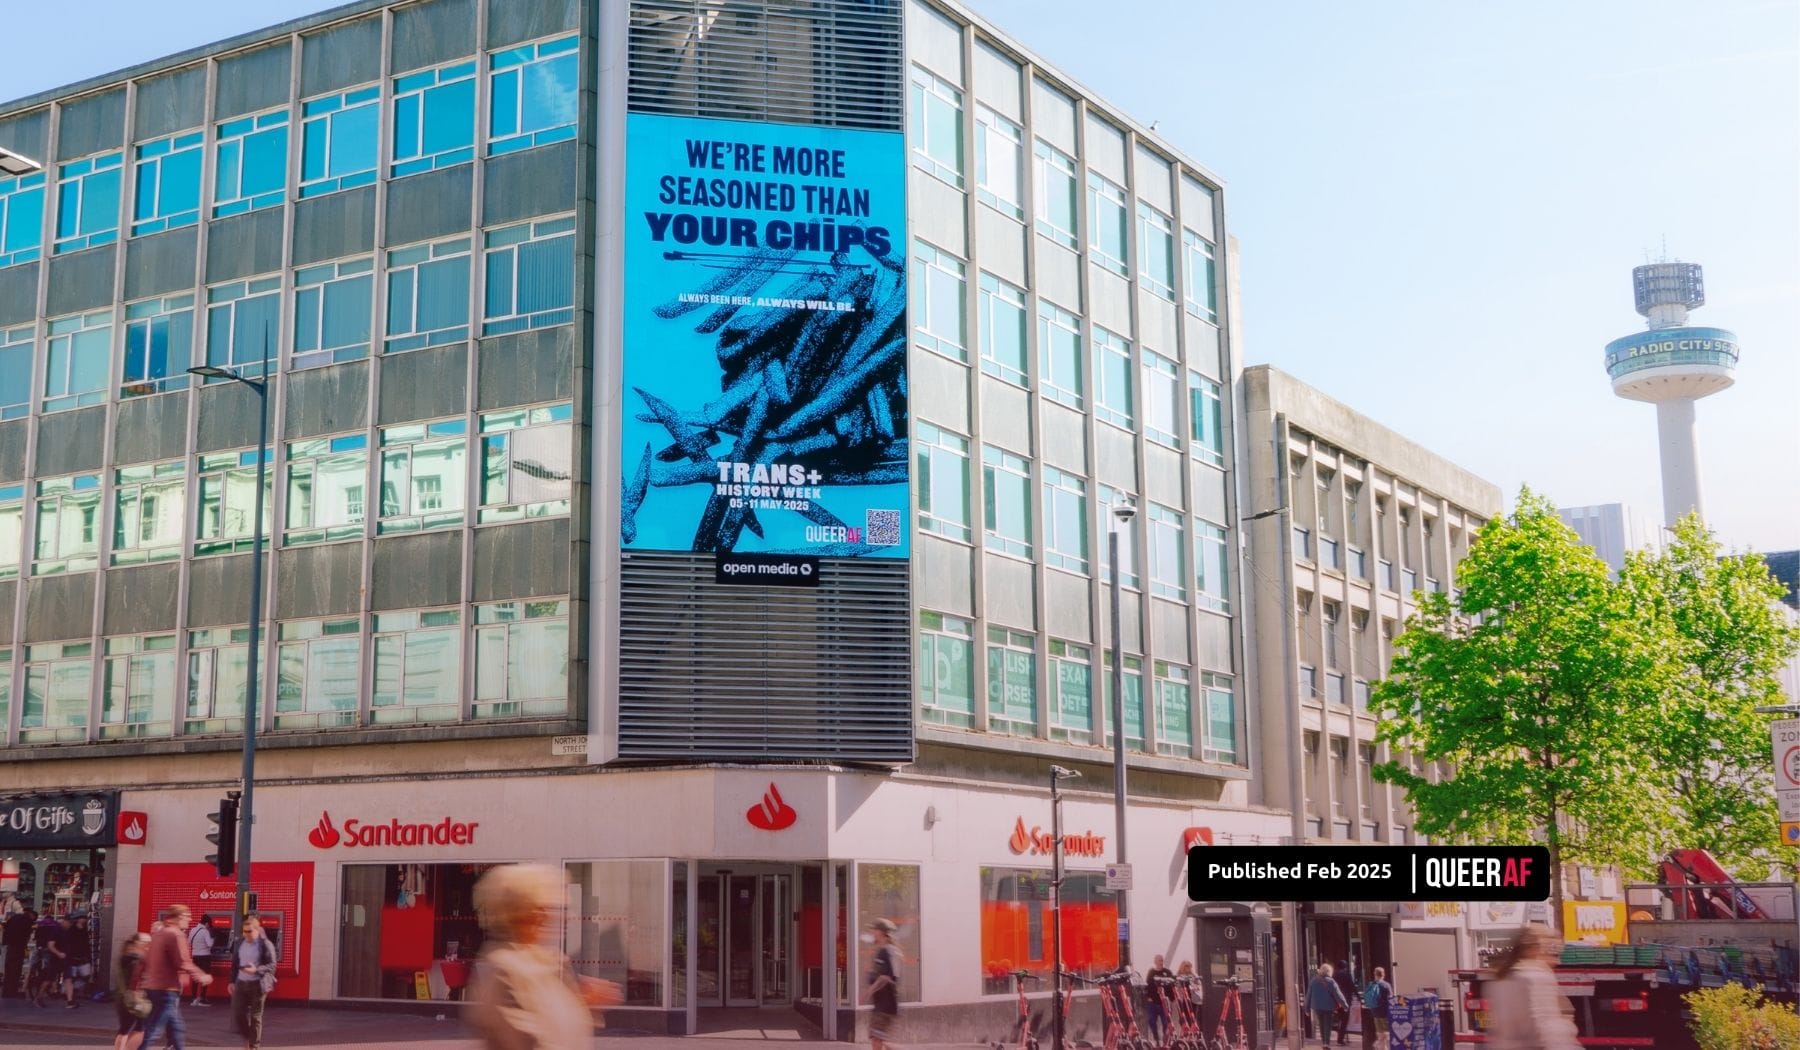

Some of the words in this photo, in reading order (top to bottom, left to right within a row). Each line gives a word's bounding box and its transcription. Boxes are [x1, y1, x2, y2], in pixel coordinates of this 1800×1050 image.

[685, 139, 765, 173] WE’RE
[773, 145, 846, 178] MORE
[658, 175, 796, 213] SEASONED
[801, 185, 870, 217] THAN
[644, 212, 760, 249] YOUR
[678, 293, 710, 303] ALWAYS
[710, 296, 731, 305] BEEN
[756, 297, 806, 310] ALWAYS
[805, 300, 837, 311] WILL
[836, 302, 856, 312] BE.
[1628, 340, 1675, 357] RADIO
[1679, 339, 1712, 350] CITY
[717, 461, 823, 485] TRANS+
[716, 484, 780, 498] HISTORY
[783, 486, 822, 499] WEEK
[761, 499, 784, 510] MAY
[784, 500, 809, 511] 2025
[805, 525, 862, 544] QUEERAF
[723, 562, 756, 576] open
[758, 562, 798, 575] media
[554, 736, 577, 745] NORTH
[562, 745, 586, 753] STREET
[10, 807, 35, 834] Of
[35, 806, 75, 833] Gifts
[343, 816, 479, 848] Santander
